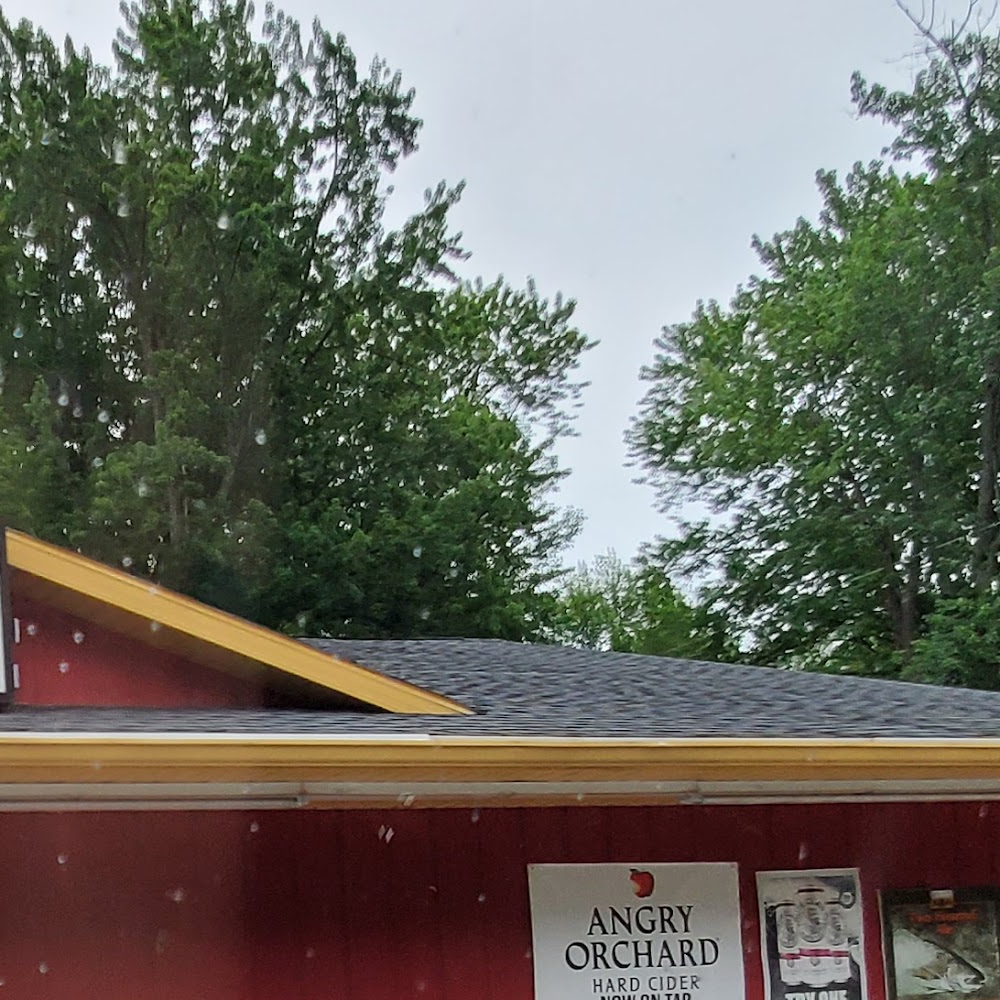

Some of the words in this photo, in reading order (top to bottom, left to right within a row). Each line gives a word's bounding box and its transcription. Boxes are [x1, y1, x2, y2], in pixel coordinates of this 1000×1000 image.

[587, 906, 693, 936] ANGRY
[565, 938, 720, 971] ORCHARD
[593, 977, 641, 993] HARD
[648, 975, 700, 991] CIDER
